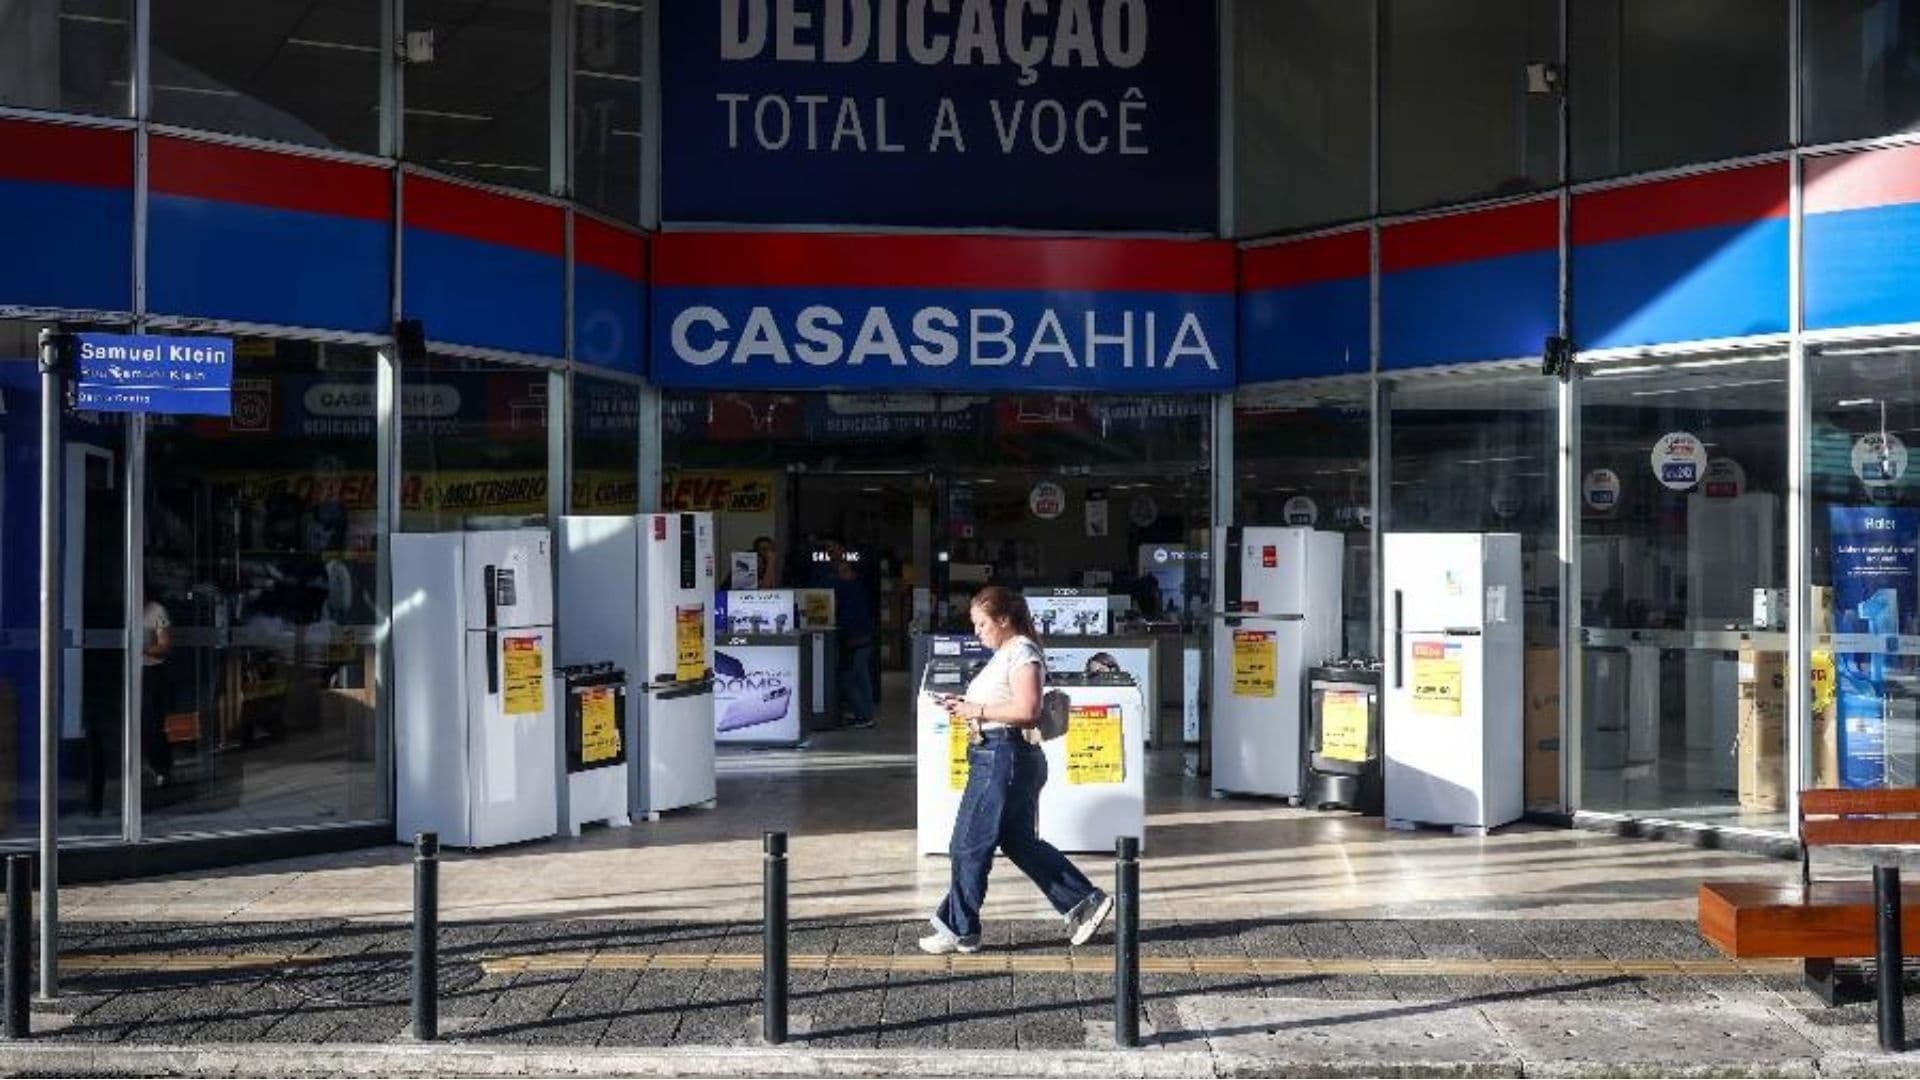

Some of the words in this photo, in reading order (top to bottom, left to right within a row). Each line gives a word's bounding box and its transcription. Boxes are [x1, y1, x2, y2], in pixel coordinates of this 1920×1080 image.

[717, 93, 905, 153] TOTAL
[929, 99, 966, 153] A
[990, 87, 1149, 155] VOCÊ
[80, 342, 162, 362] Samuel
[169, 345, 226, 364] Klein
